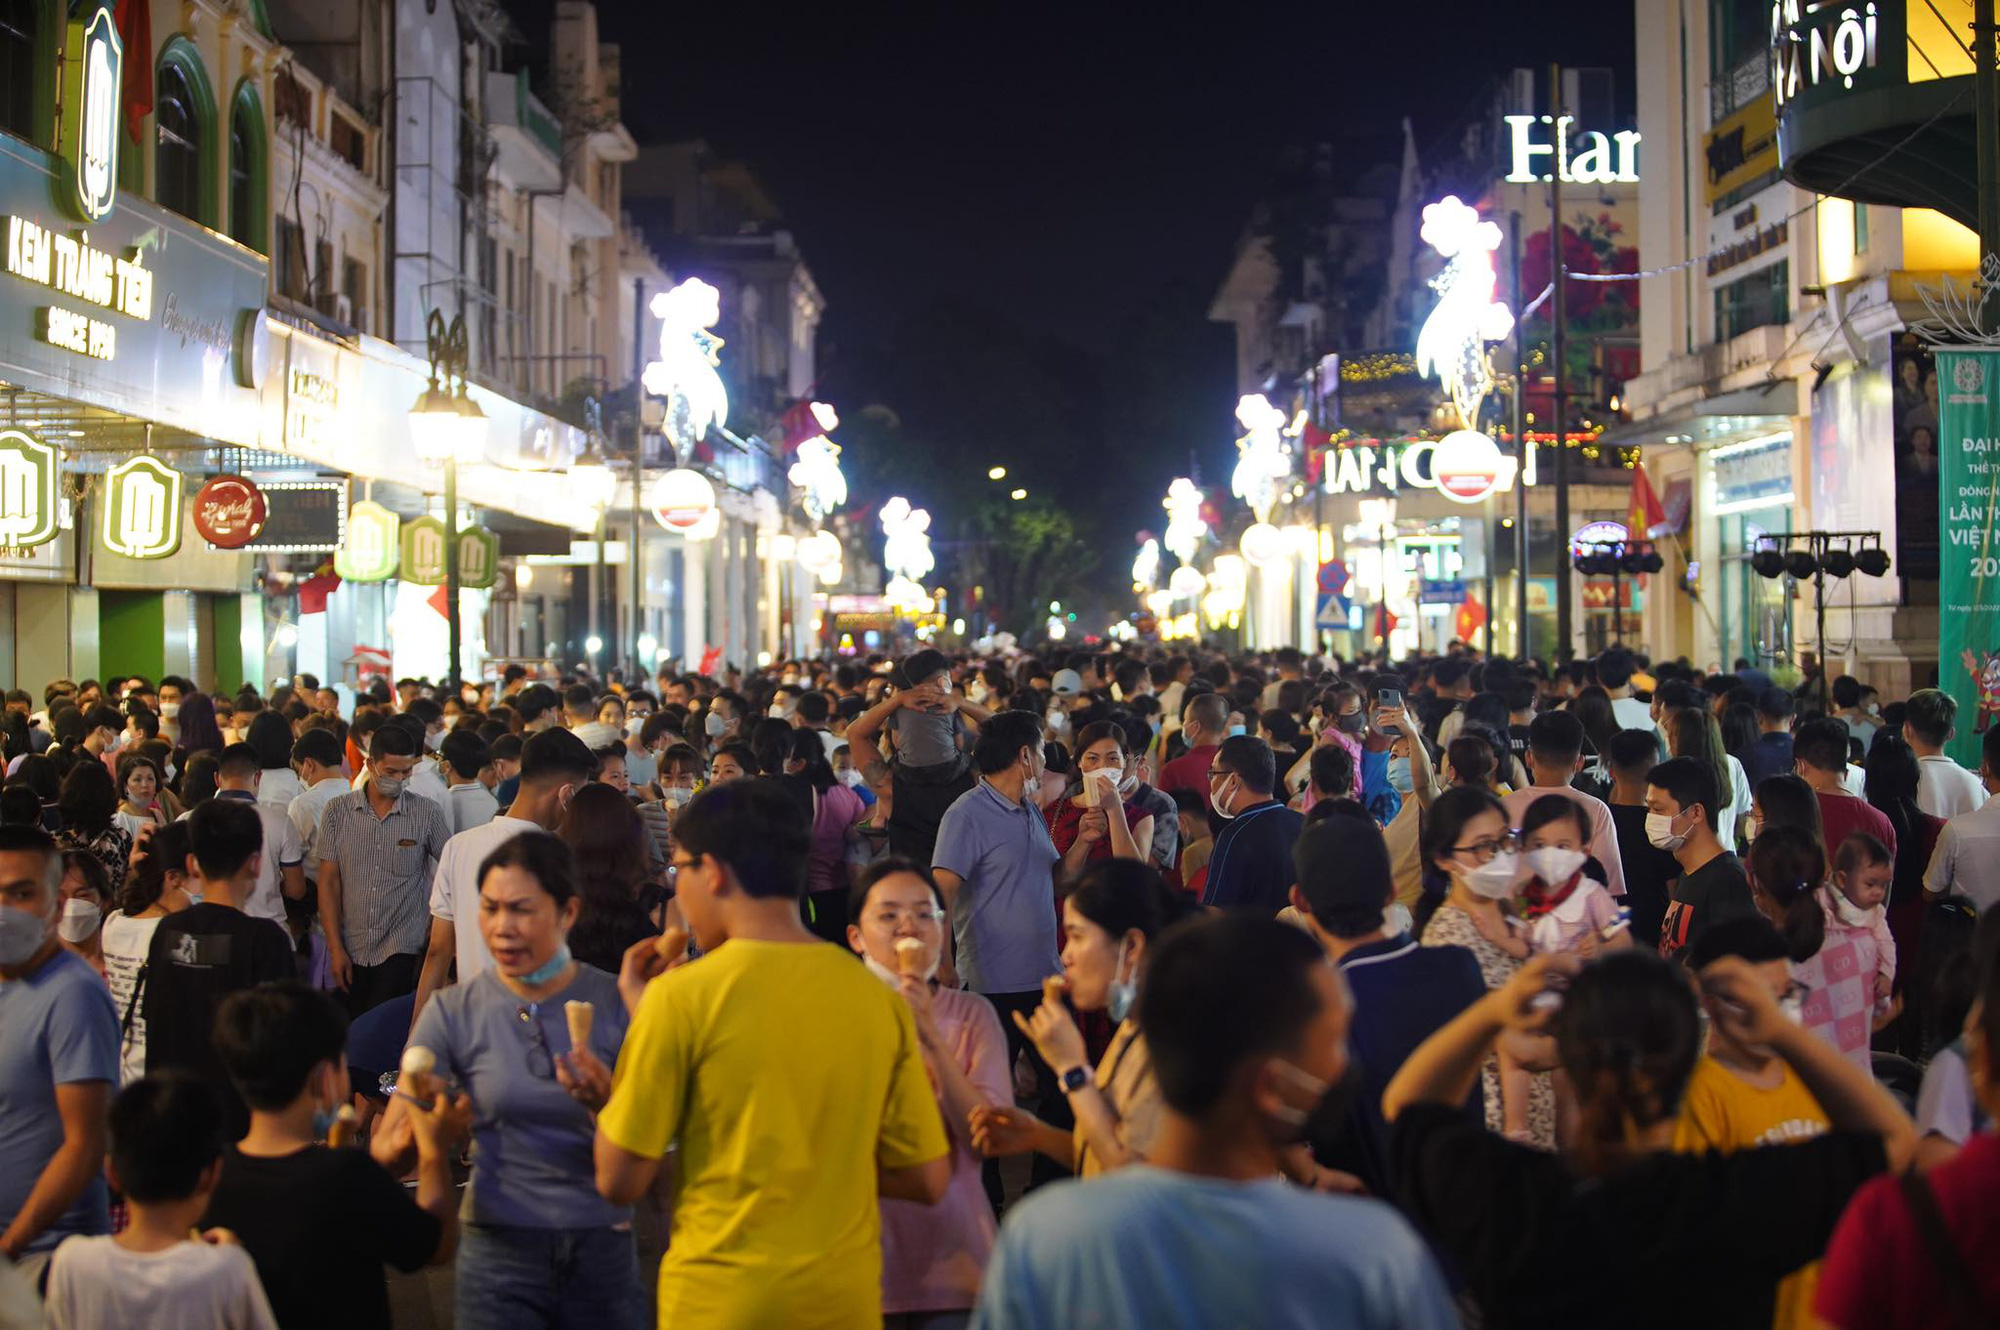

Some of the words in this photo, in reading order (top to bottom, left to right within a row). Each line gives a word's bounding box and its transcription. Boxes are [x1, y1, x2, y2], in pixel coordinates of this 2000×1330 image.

[8, 215, 51, 285] KEM
[55, 229, 114, 307] TRÀNG
[47, 305, 88, 353] SINCE
[1962, 438, 1992, 456] ĐẠI
[1967, 460, 1989, 474] THỂ
[1959, 484, 1990, 497] ĐÔNG
[1949, 500, 1982, 520] LẦN
[1949, 525, 1990, 551] VIỆT
[1970, 557, 2000, 578] 20
